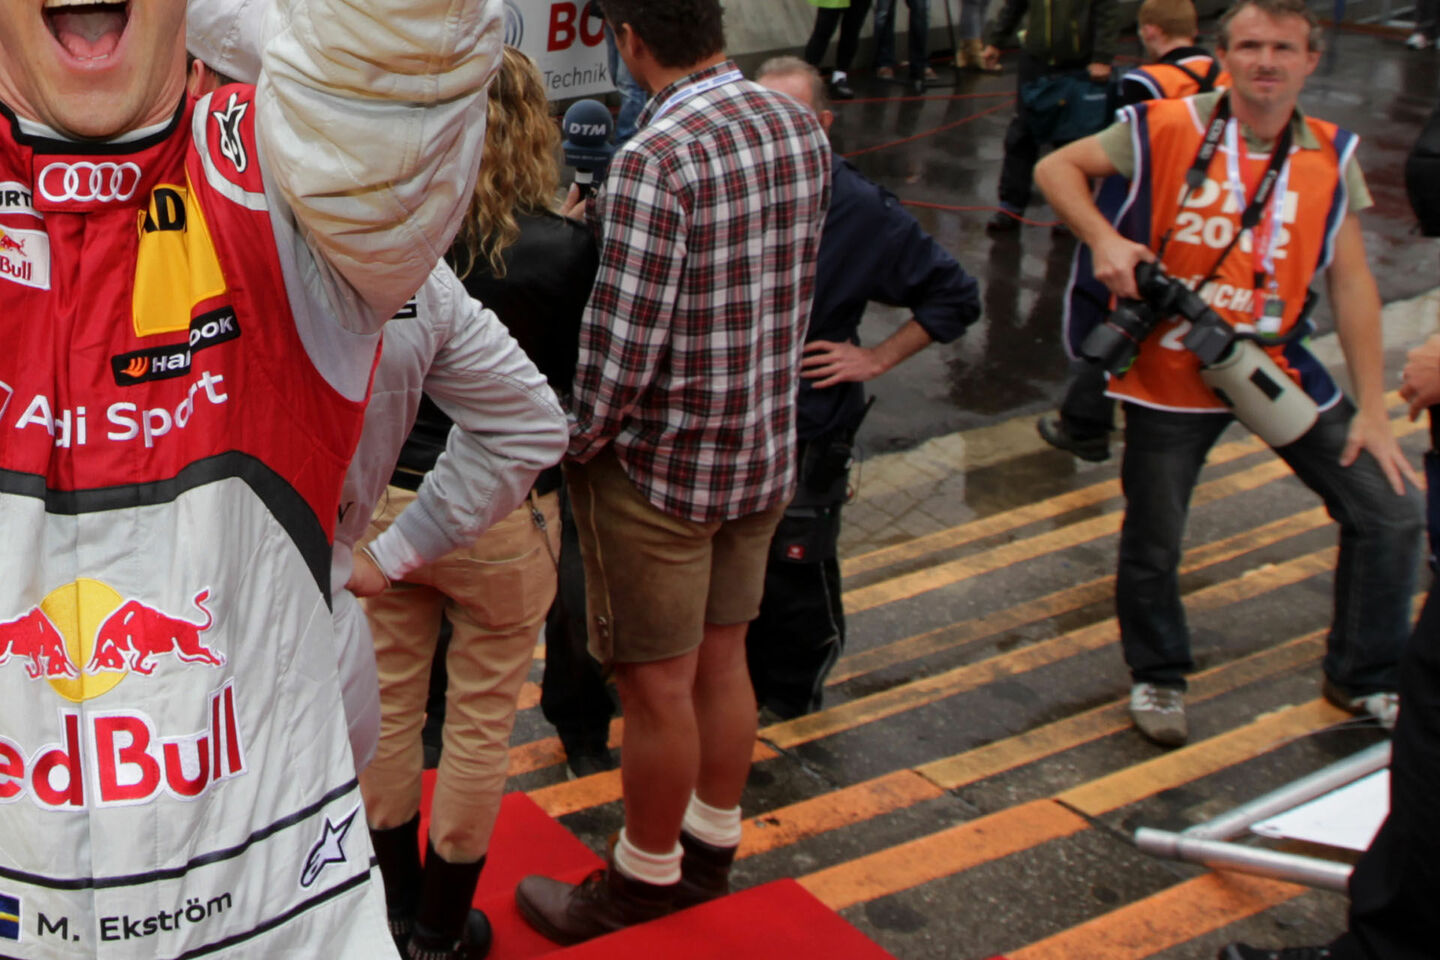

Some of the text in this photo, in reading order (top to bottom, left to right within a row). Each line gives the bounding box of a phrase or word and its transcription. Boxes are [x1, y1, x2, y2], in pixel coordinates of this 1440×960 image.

[545, 63, 607, 89] Technik
[569, 122, 607, 136] DTM
[0, 255, 32, 281] Bull
[106, 371, 229, 448] Sport
[93, 685, 244, 803] Bull
[36, 890, 233, 942] M. Ekström
